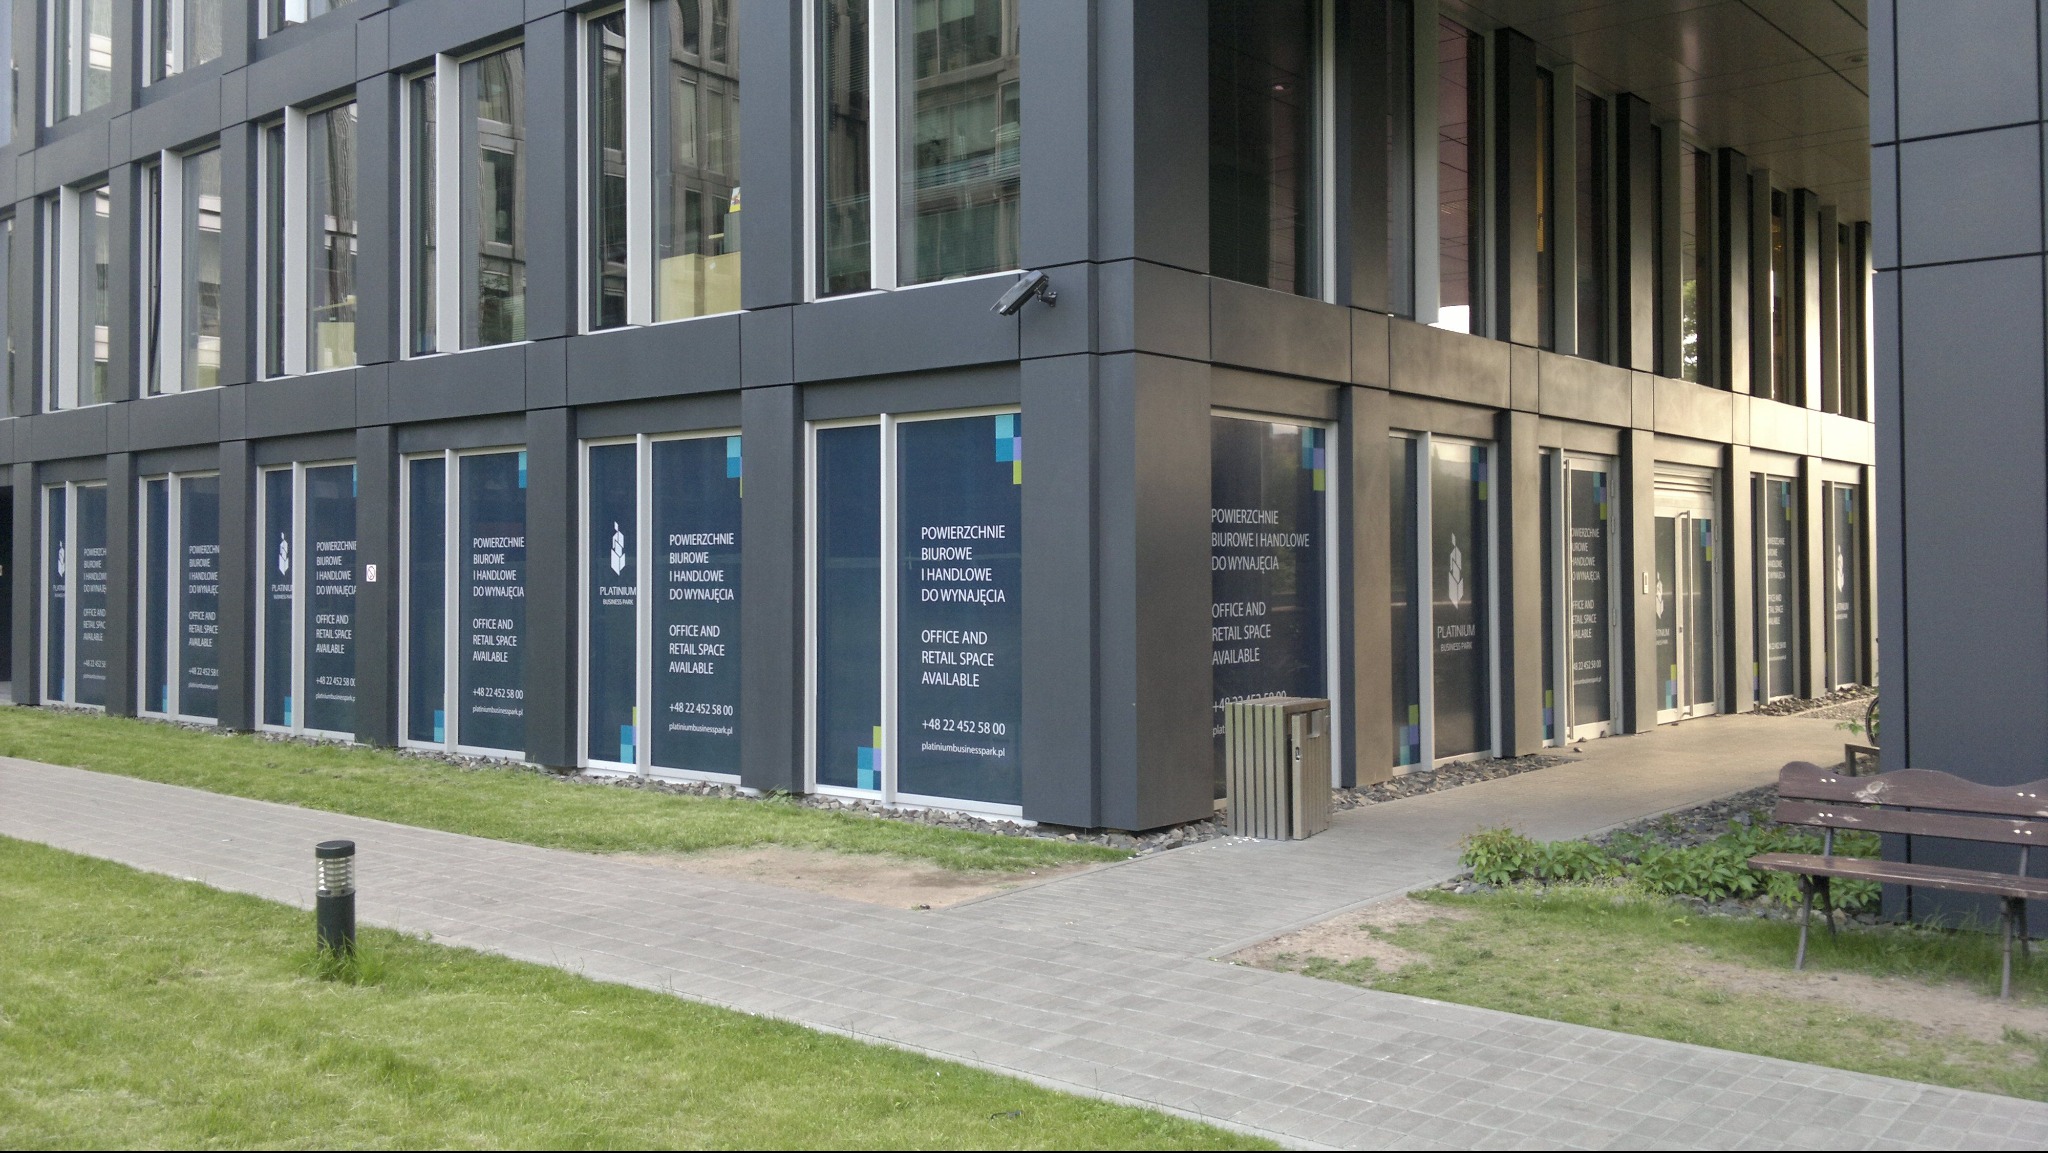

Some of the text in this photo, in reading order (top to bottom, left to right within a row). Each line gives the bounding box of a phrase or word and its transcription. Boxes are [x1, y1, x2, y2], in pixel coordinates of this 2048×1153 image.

[1211, 508, 1279, 525] POWIERZCHNIE
[921, 525, 1006, 540] POWIERZCHNIE
[473, 536, 525, 548] POWIERZCHNIE
[669, 532, 735, 546] POWIERZCHNIE
[1211, 532, 1254, 547] BIUROWE
[1260, 533, 1310, 547] HANDLOWE
[473, 554, 505, 564] BIUROWE
[669, 552, 709, 564] BIUROWE
[921, 547, 973, 561] BIUROWE
[316, 556, 342, 566] BIUROWE
[1211, 556, 1279, 574] DO WYNAJĘCIA
[320, 571, 351, 580] HANDLOWE
[477, 570, 516, 580] HANDLOWE
[674, 570, 724, 582] HANDLOWE
[927, 567, 992, 581] HANDLOWE
[316, 586, 325, 595] DO
[473, 586, 525, 599] DO WYNAJĘCIA
[599, 586, 637, 596] PLATINIUM
[669, 588, 735, 603] DO WYNAJĘCIA
[921, 588, 1006, 606] DO WYNAJĘCIA
[1211, 601, 1266, 618] OFFICE AND
[1584, 600, 1594, 610] AND
[188, 611, 216, 620] OFFICE AND
[316, 614, 349, 624] OFFICE AND
[1584, 613, 1597, 624] SPACE
[188, 624, 218, 634] RETAIL SPACE
[472, 618, 514, 630] OFFICE AND
[316, 629, 352, 639] RETAIL SPACE
[669, 625, 720, 637] OFFICE AND
[921, 629, 988, 645] OFFICE AND
[1212, 623, 1271, 642] RETAIL SPACE
[1437, 624, 1476, 638] PLATINIUM
[188, 637, 212, 647] AVAILABLE
[472, 634, 517, 646] RETAIL SPACE
[316, 644, 344, 654] AVAILABLE
[669, 643, 725, 656] RETAIL SPACE
[472, 651, 508, 663] AVAILABLE
[921, 650, 994, 667] RETAIL SPACE
[1211, 647, 1260, 666] AVAILABLE
[669, 661, 714, 674] AVAILABLE
[316, 677, 326, 685] +48
[333, 677, 342, 686] 452
[921, 671, 980, 687] AVAILABLE
[472, 687, 524, 699] +48 22 452 58 00
[669, 702, 733, 716] +48 22 452 58 00
[668, 722, 733, 736] platiniumbusinesspark.pl
[922, 718, 1006, 735] +48 22 452 58 00
[921, 741, 1006, 758] platiniumbusinesspark.pl
